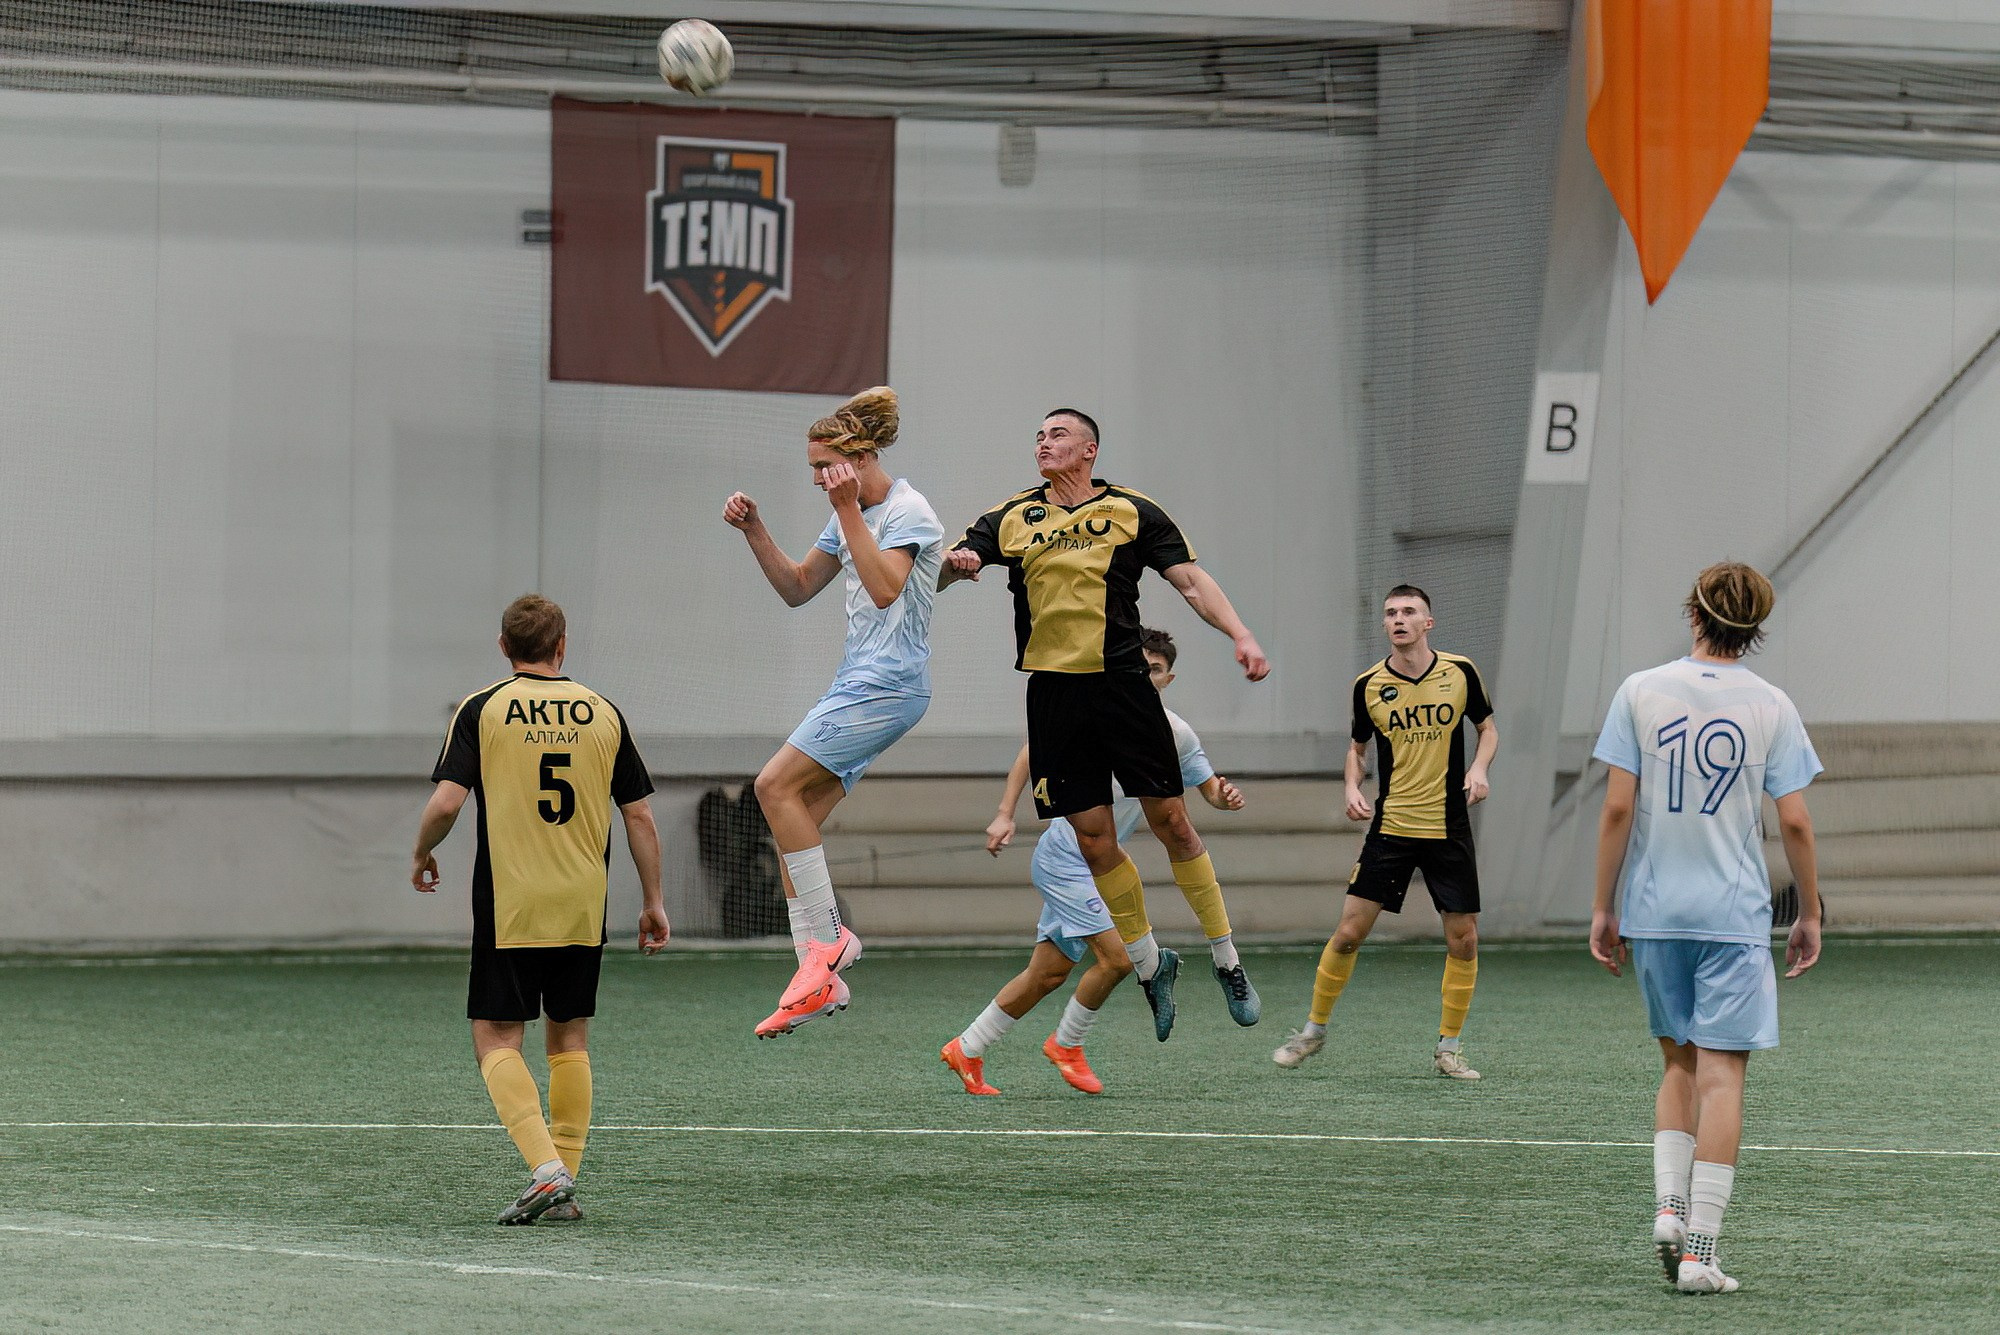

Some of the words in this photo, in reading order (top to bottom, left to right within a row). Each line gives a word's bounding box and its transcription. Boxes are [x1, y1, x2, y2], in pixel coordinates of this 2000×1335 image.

[661, 200, 779, 277] ТЕМП
[504, 698, 594, 725] АКТО
[1389, 703, 1454, 731] АКТО
[524, 727, 579, 744] АЛТАЙ
[1657, 715, 1746, 816] 19
[537, 752, 575, 825] 5
[1033, 777, 1051, 806] 4
